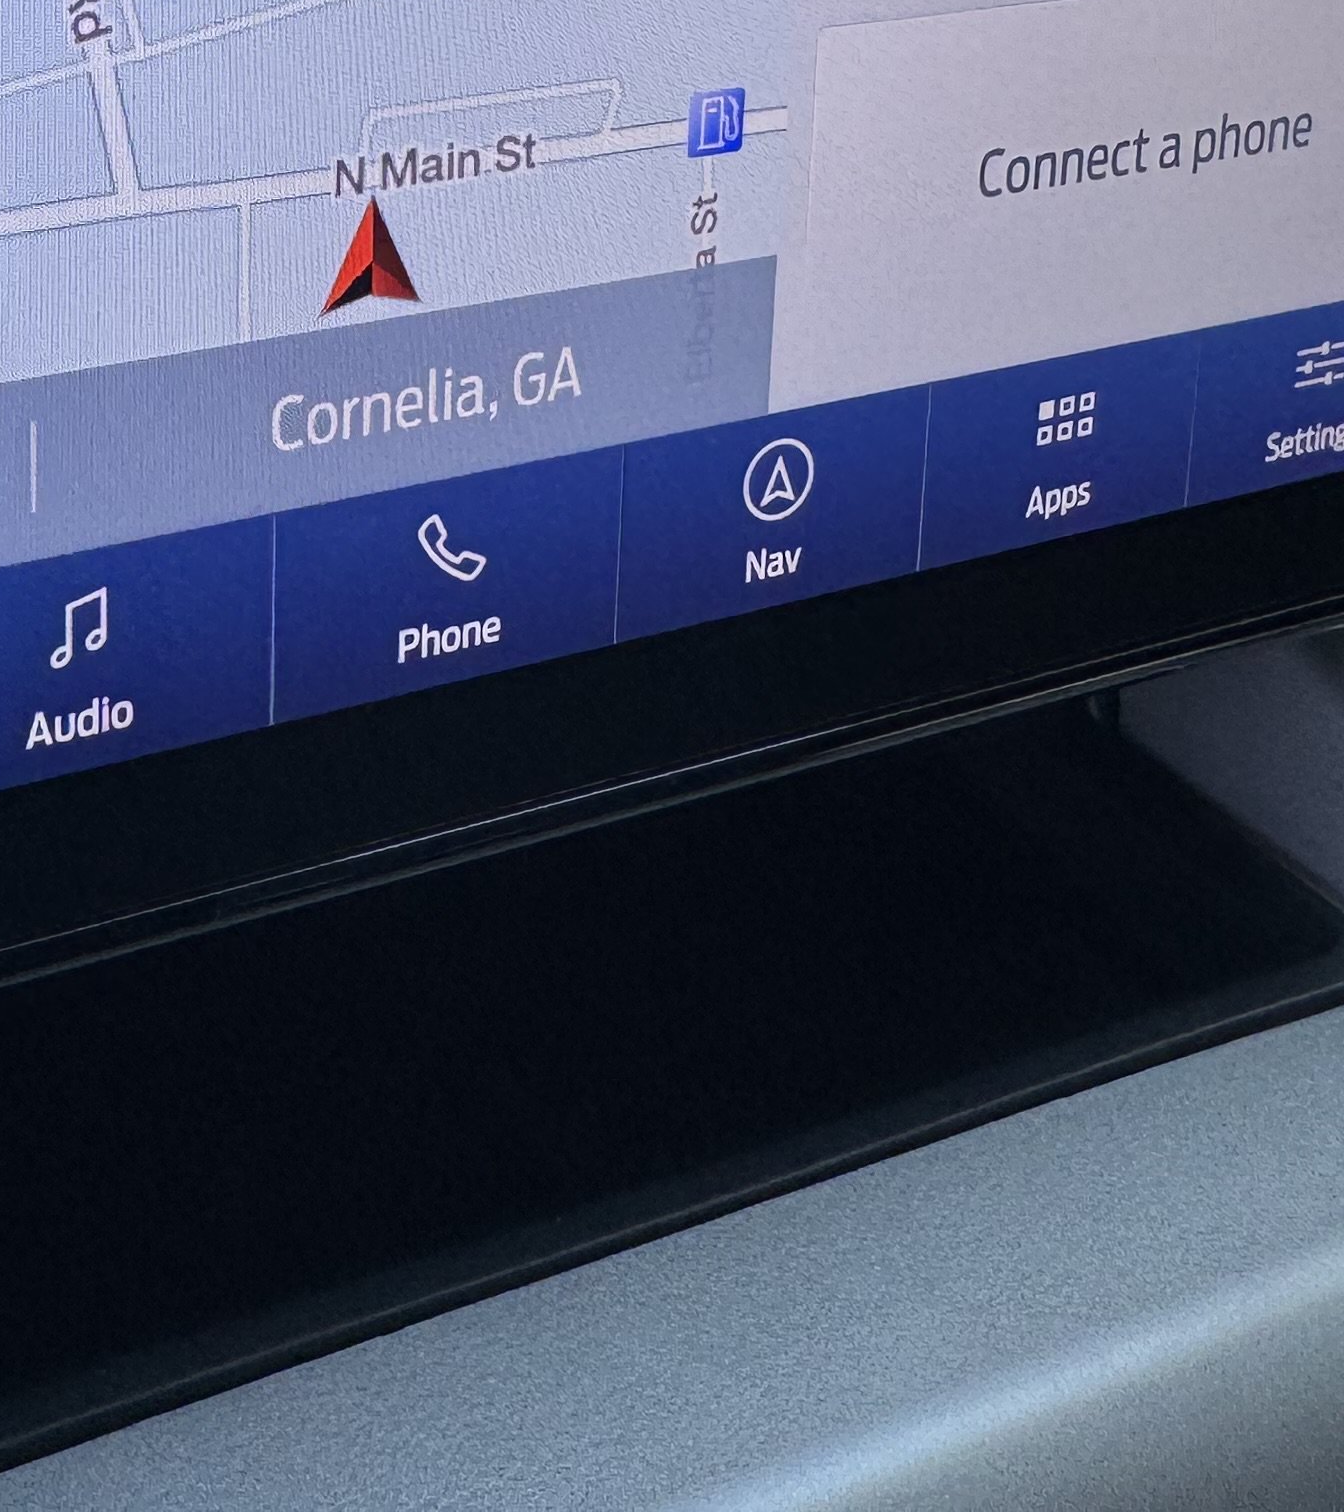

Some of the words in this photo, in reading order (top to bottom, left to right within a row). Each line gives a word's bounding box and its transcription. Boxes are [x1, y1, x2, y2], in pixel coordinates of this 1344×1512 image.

[335, 159, 364, 197] N
[381, 142, 480, 192] Main
[495, 133, 536, 173] St
[977, 127, 1150, 200] Connect
[1159, 127, 1183, 170] a
[1192, 107, 1313, 174] phone
[690, 192, 718, 235] St
[270, 368, 501, 454] Cornelia,
[513, 345, 582, 409] GA
[1025, 478, 1092, 520] Apps
[745, 546, 802, 584] Nav
[397, 615, 501, 664] Phone
[25, 695, 135, 751] Audio
